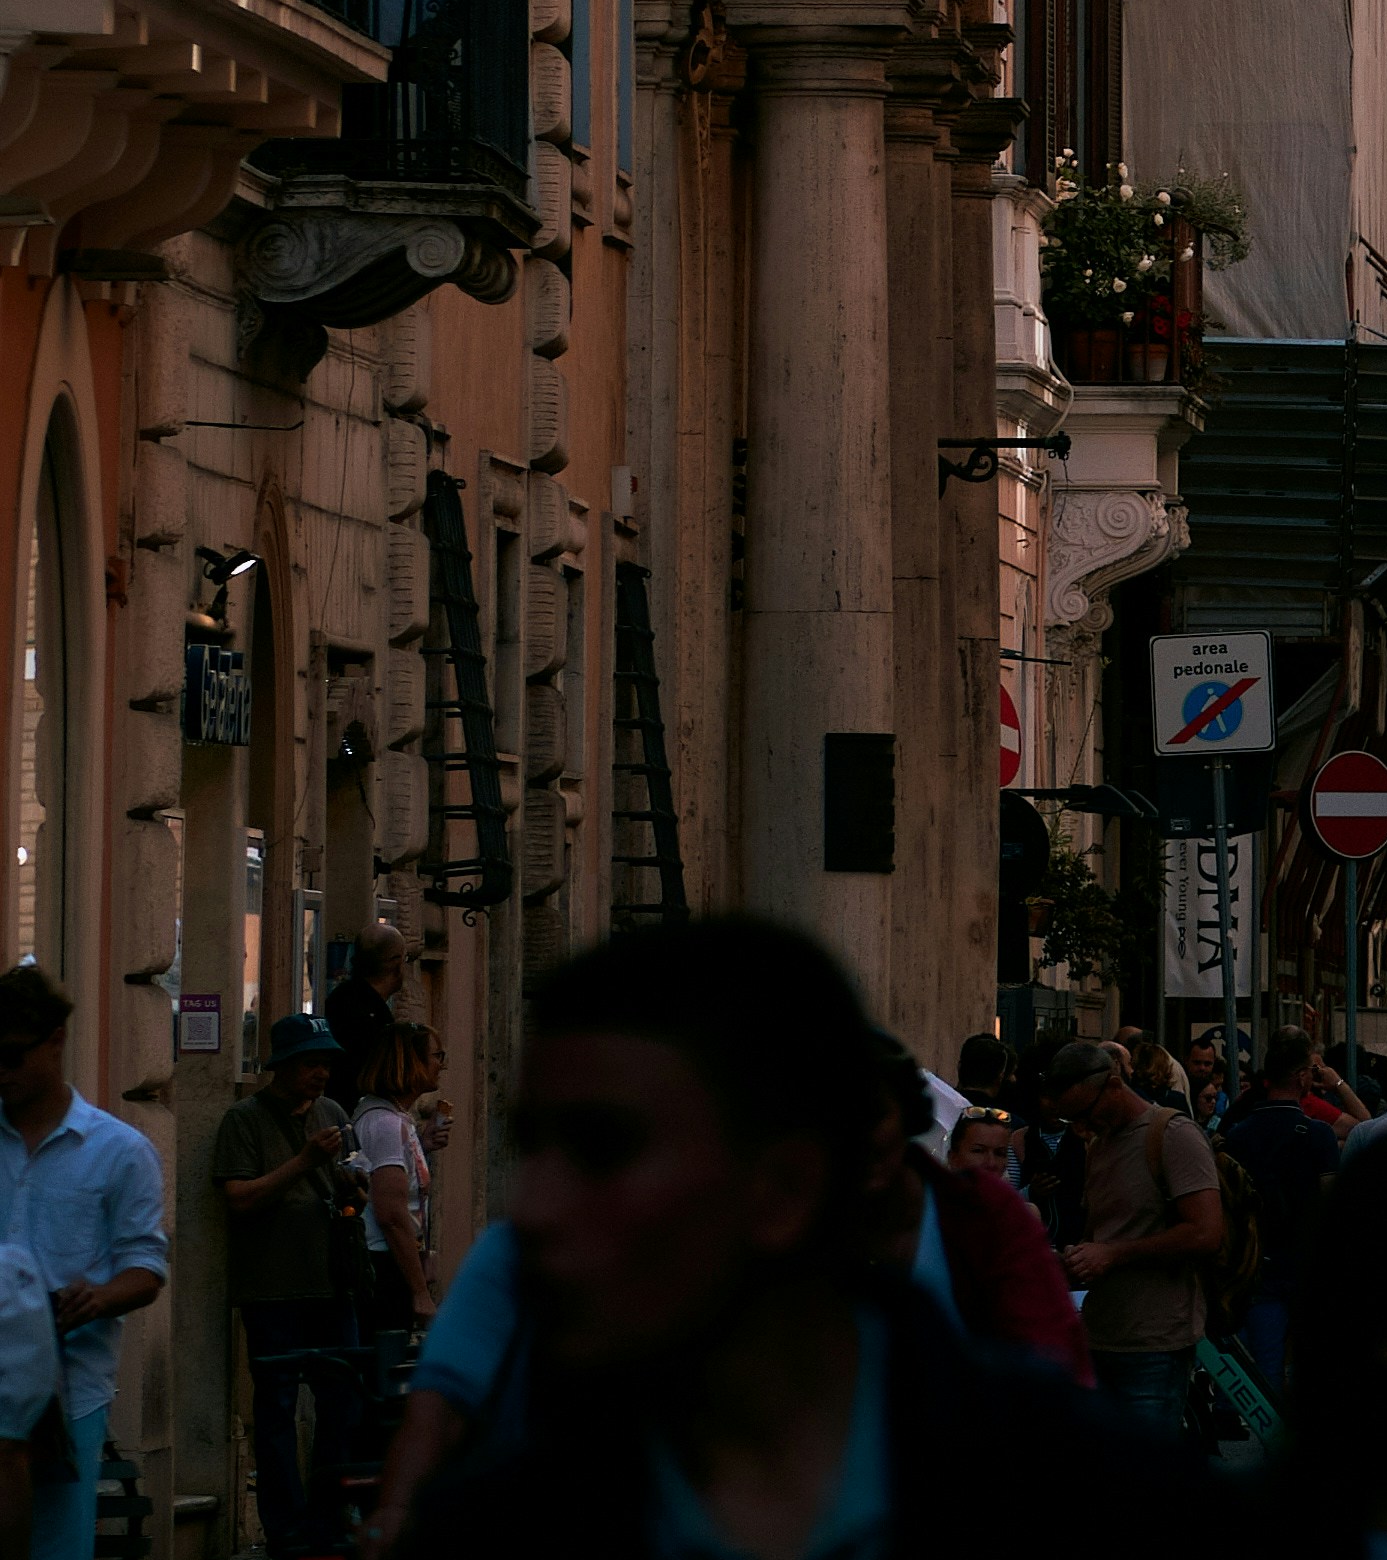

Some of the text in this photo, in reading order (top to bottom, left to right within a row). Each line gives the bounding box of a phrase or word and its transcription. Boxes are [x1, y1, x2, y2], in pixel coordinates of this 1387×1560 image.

[1193, 643, 1228, 655] area
[1173, 660, 1249, 679] pedonale
[1176, 877, 1189, 921] Young
[183, 999, 217, 1008] TAG US
[1216, 1355, 1273, 1434] TIER
